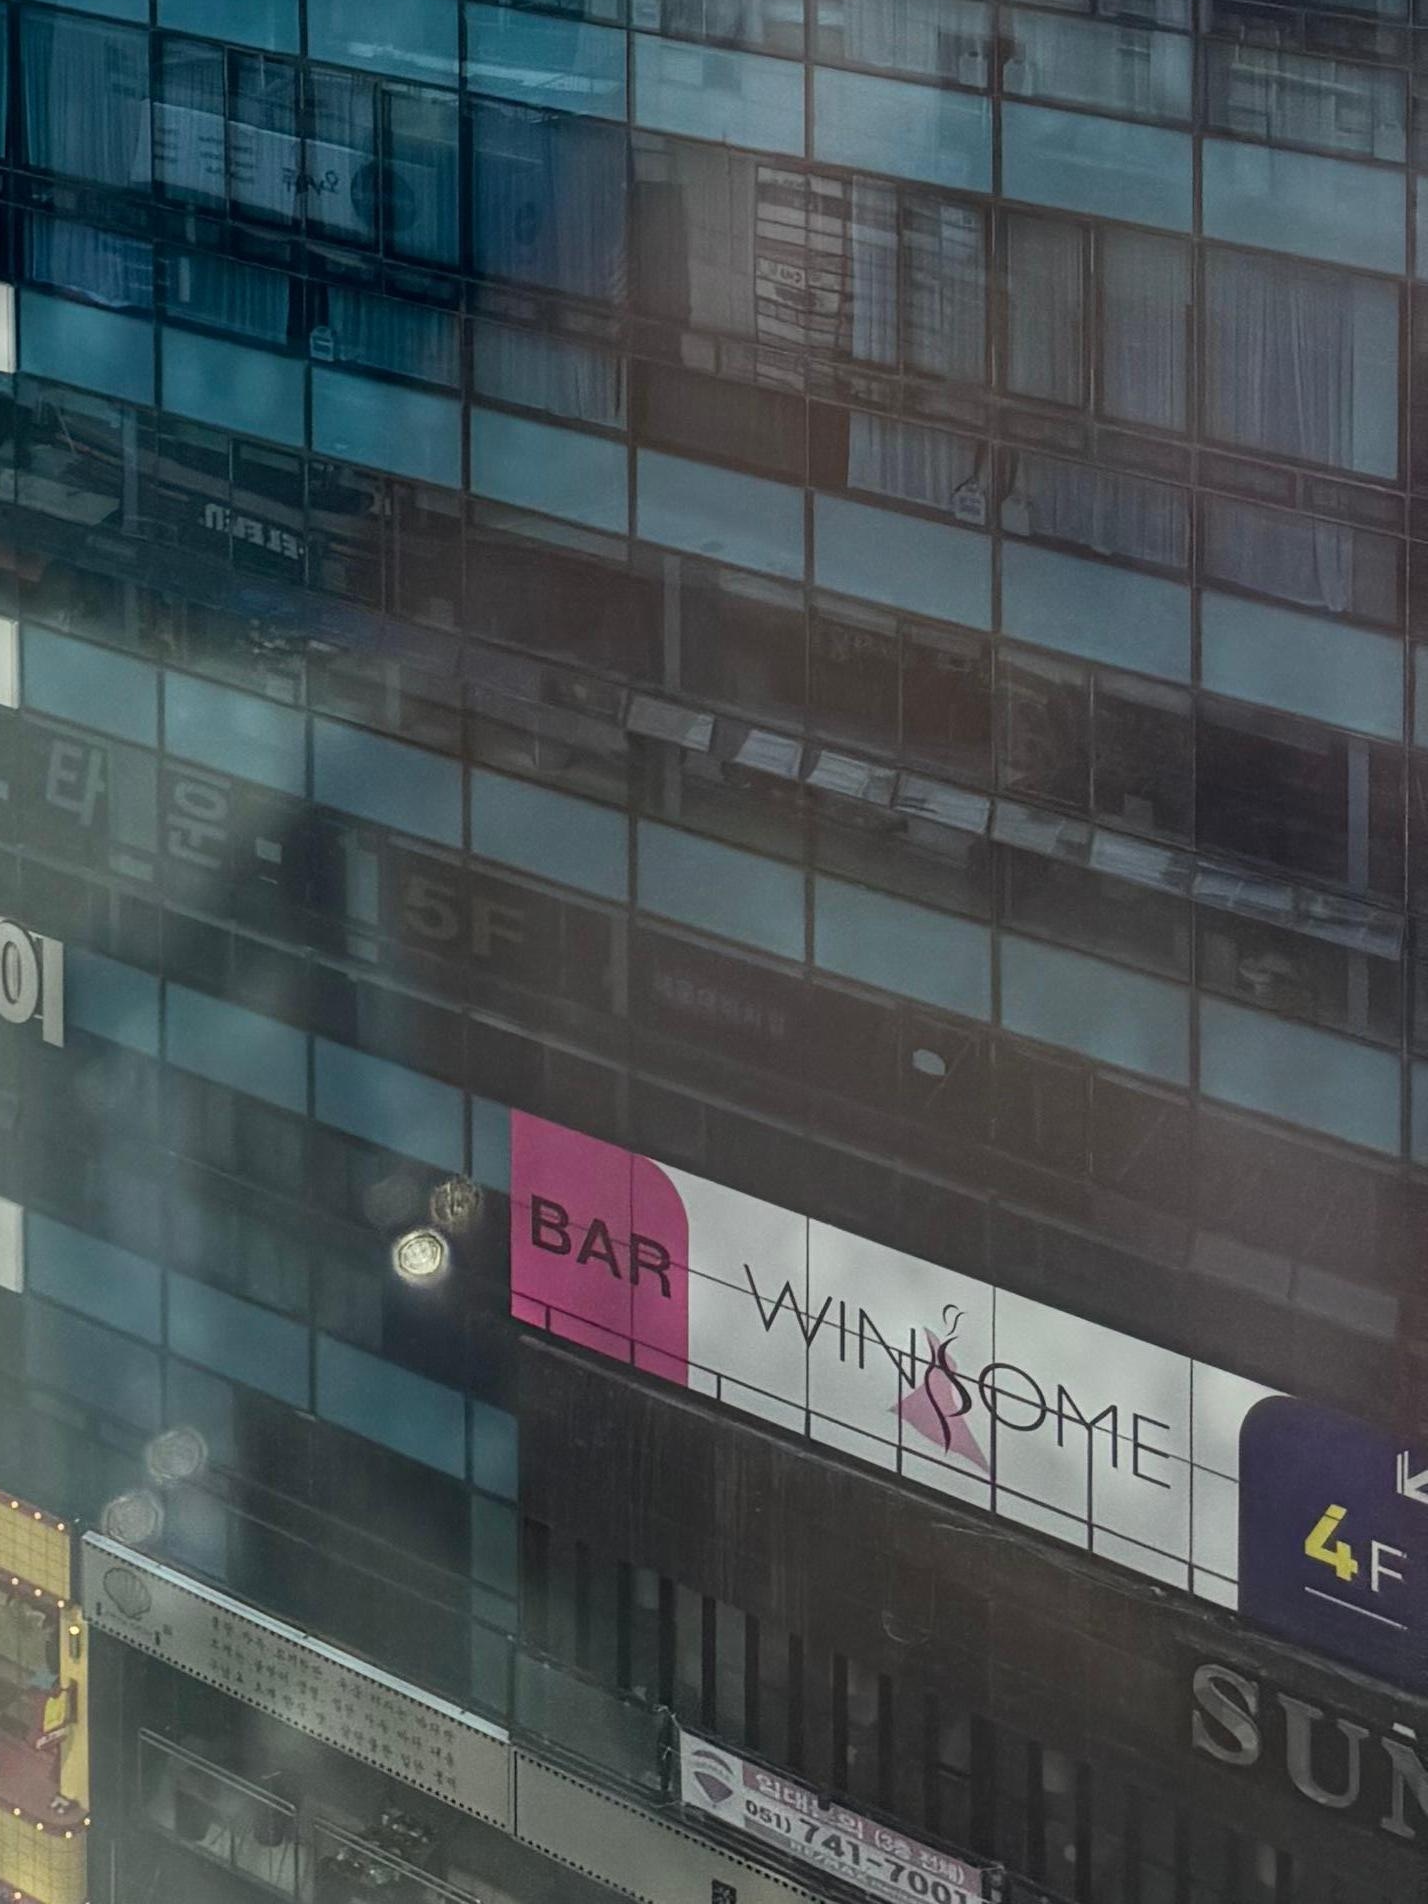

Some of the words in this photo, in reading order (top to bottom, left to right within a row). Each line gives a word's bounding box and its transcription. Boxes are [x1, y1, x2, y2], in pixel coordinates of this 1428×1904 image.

[529, 1194, 674, 1300] BAR
[1303, 1503, 1408, 1593] 4F
[745, 1797, 793, 1835] 051)
